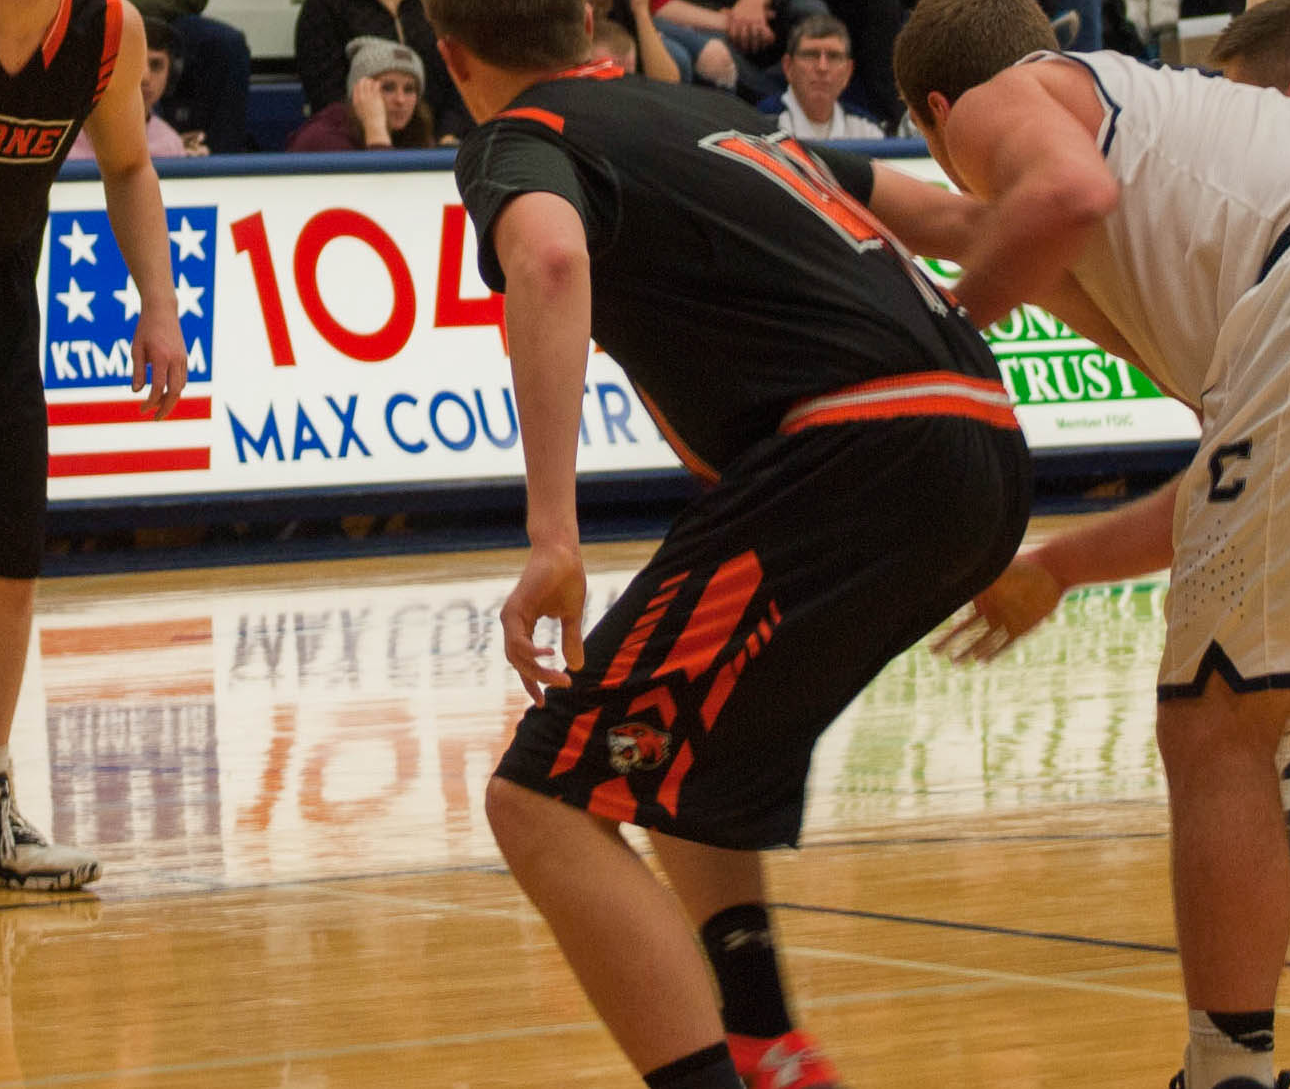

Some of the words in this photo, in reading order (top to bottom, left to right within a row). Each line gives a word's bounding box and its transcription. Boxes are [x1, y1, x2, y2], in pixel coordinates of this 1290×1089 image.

[998, 353, 1138, 405] TRUST
[226, 395, 372, 464] MAX
[1207, 436, 1253, 503] C
